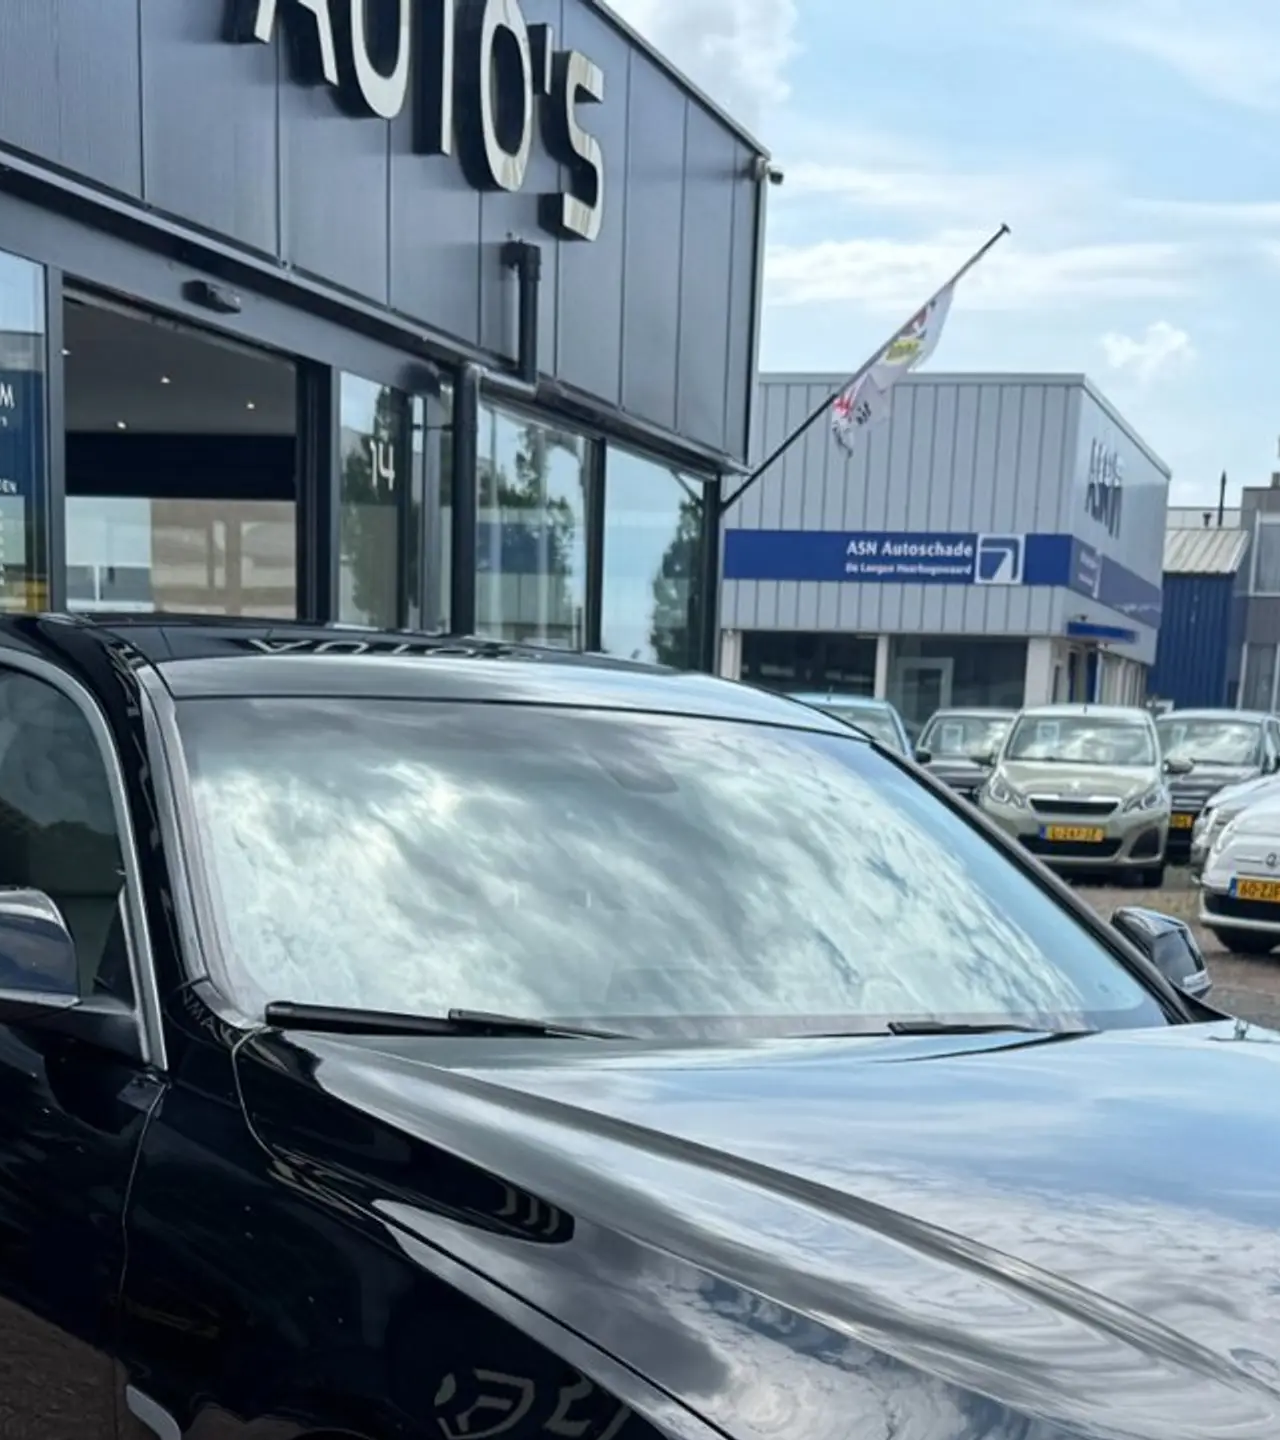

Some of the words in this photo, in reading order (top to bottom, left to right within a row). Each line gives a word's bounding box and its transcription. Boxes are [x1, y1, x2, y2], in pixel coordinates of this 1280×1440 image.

[370, 439, 395, 490] 14
[846, 540, 877, 556] ASN
[881, 539, 973, 557] Autoschade
